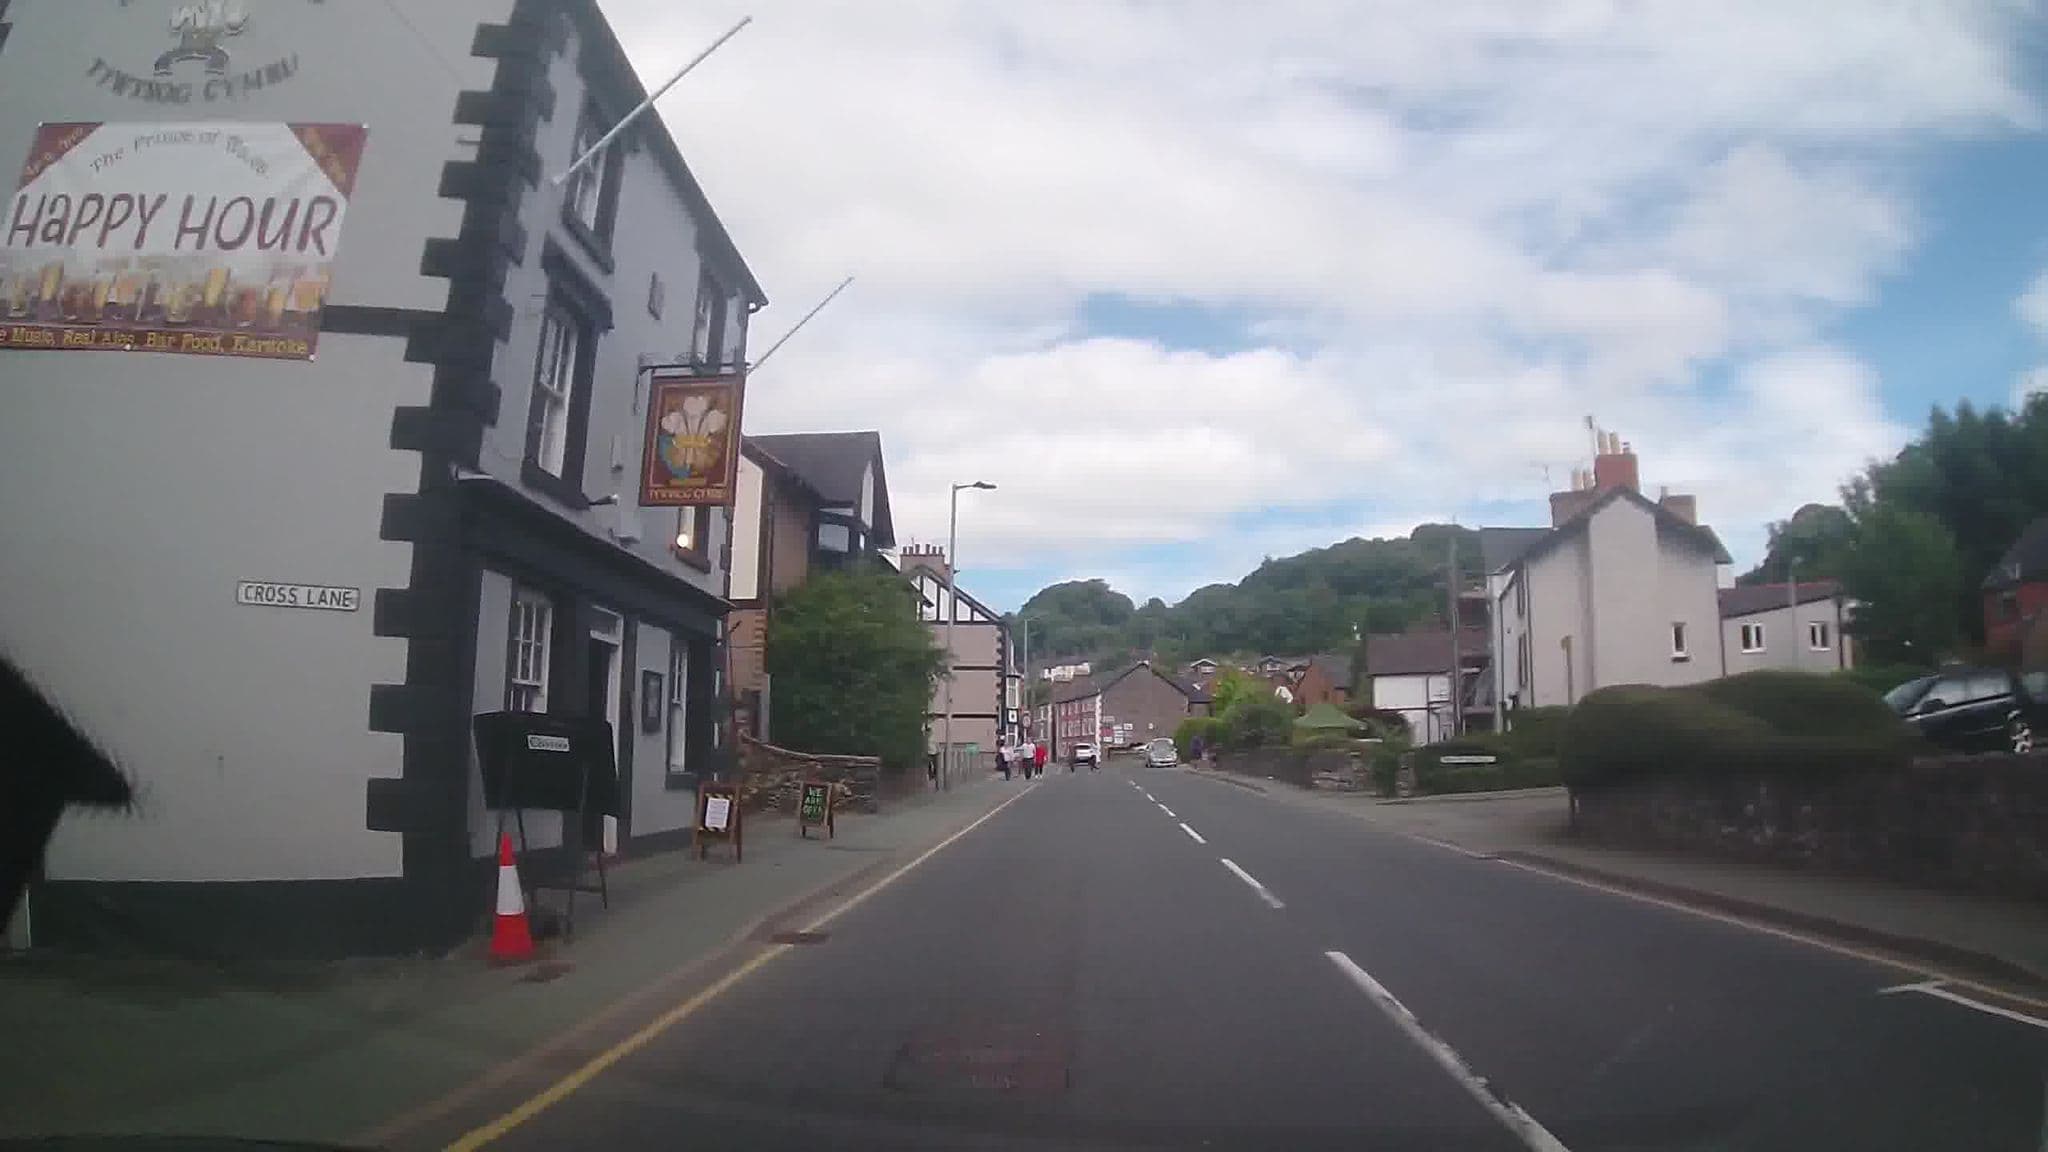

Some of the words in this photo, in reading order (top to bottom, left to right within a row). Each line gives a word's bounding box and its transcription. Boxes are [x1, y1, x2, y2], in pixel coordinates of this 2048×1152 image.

[174, 195, 339, 257] HOUR
[63, 329, 96, 345] Real
[146, 331, 179, 348] Bar
[244, 584, 299, 604] CROSS
[306, 588, 354, 608] LANE
